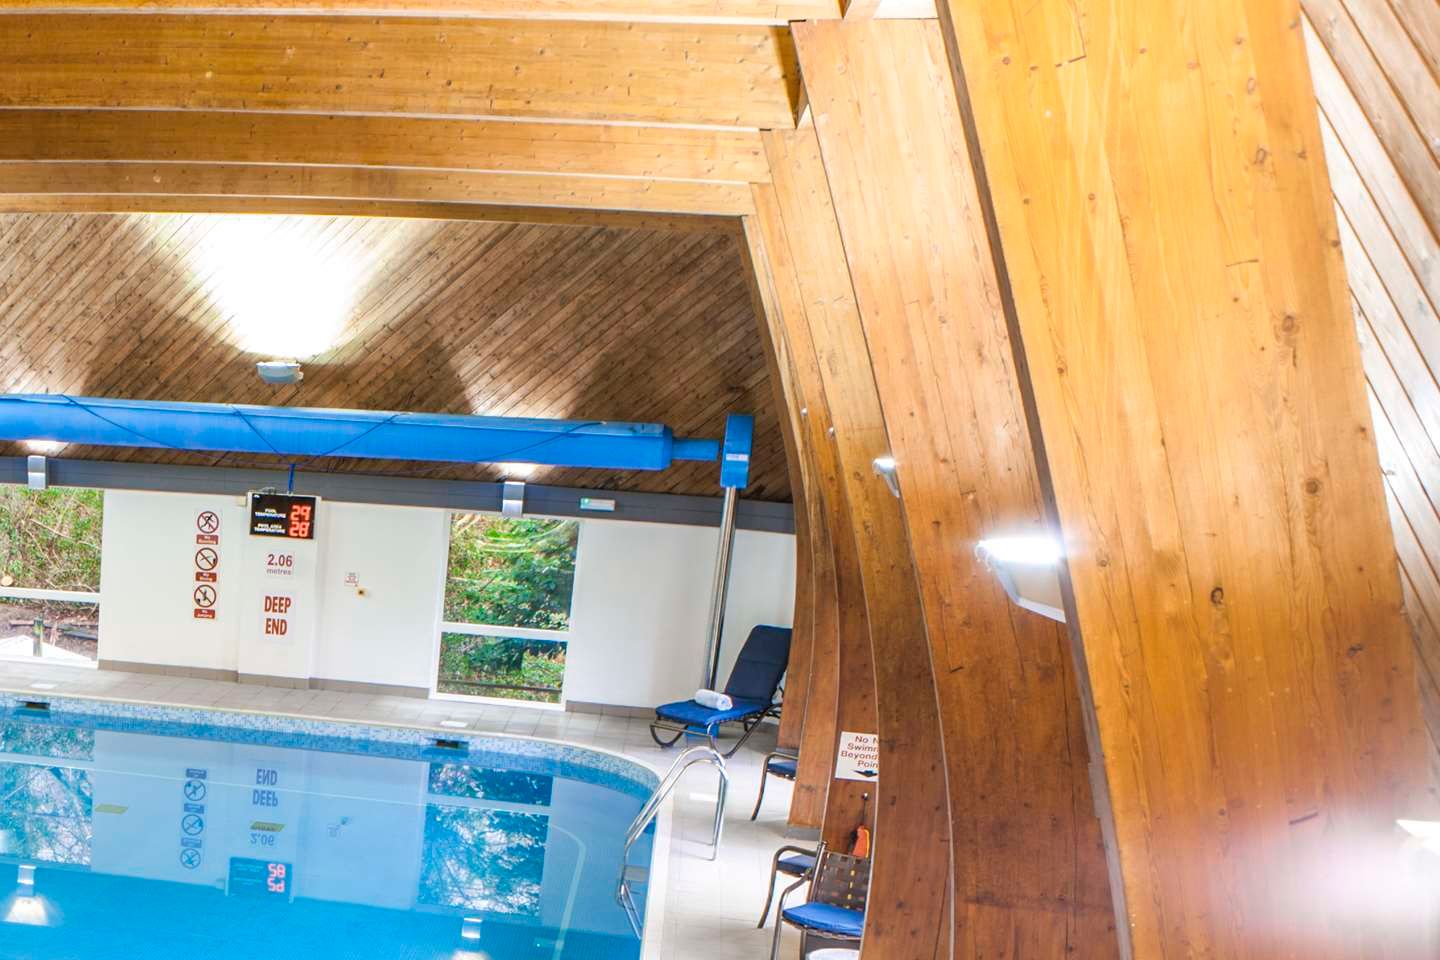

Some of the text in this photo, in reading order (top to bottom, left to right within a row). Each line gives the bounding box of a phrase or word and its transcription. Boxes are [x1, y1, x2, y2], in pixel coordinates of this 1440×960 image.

[290, 505, 312, 521] 29
[289, 521, 310, 537] 28
[267, 554, 293, 567] 2.06
[264, 596, 291, 613] DEEP
[265, 618, 288, 635] END
[857, 760, 879, 768] Poin
